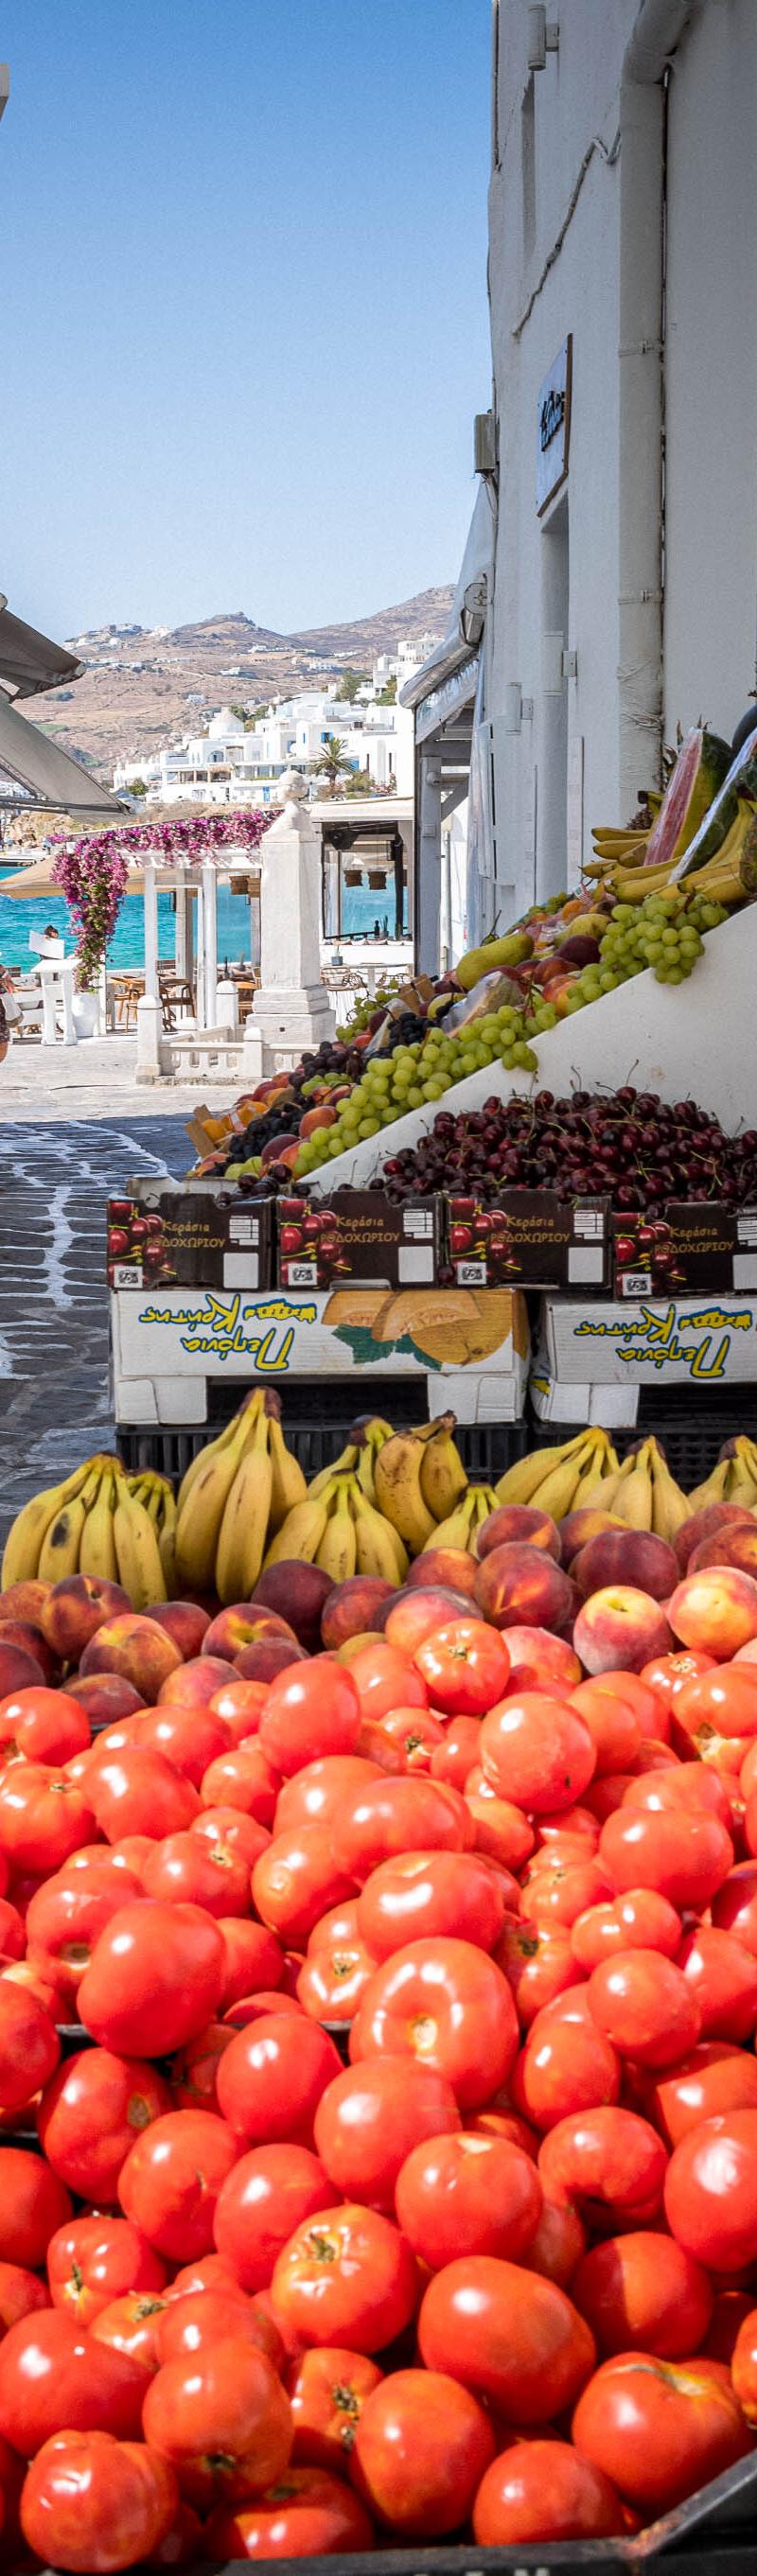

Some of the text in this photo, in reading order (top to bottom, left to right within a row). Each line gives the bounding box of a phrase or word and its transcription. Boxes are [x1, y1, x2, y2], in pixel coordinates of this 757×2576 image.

[162, 1219, 210, 1236] Κεράσια
[336, 1215, 384, 1232] Κεράσια
[506, 1215, 555, 1232] Κεράσια
[670, 1226, 718, 1241] Κεράσια
